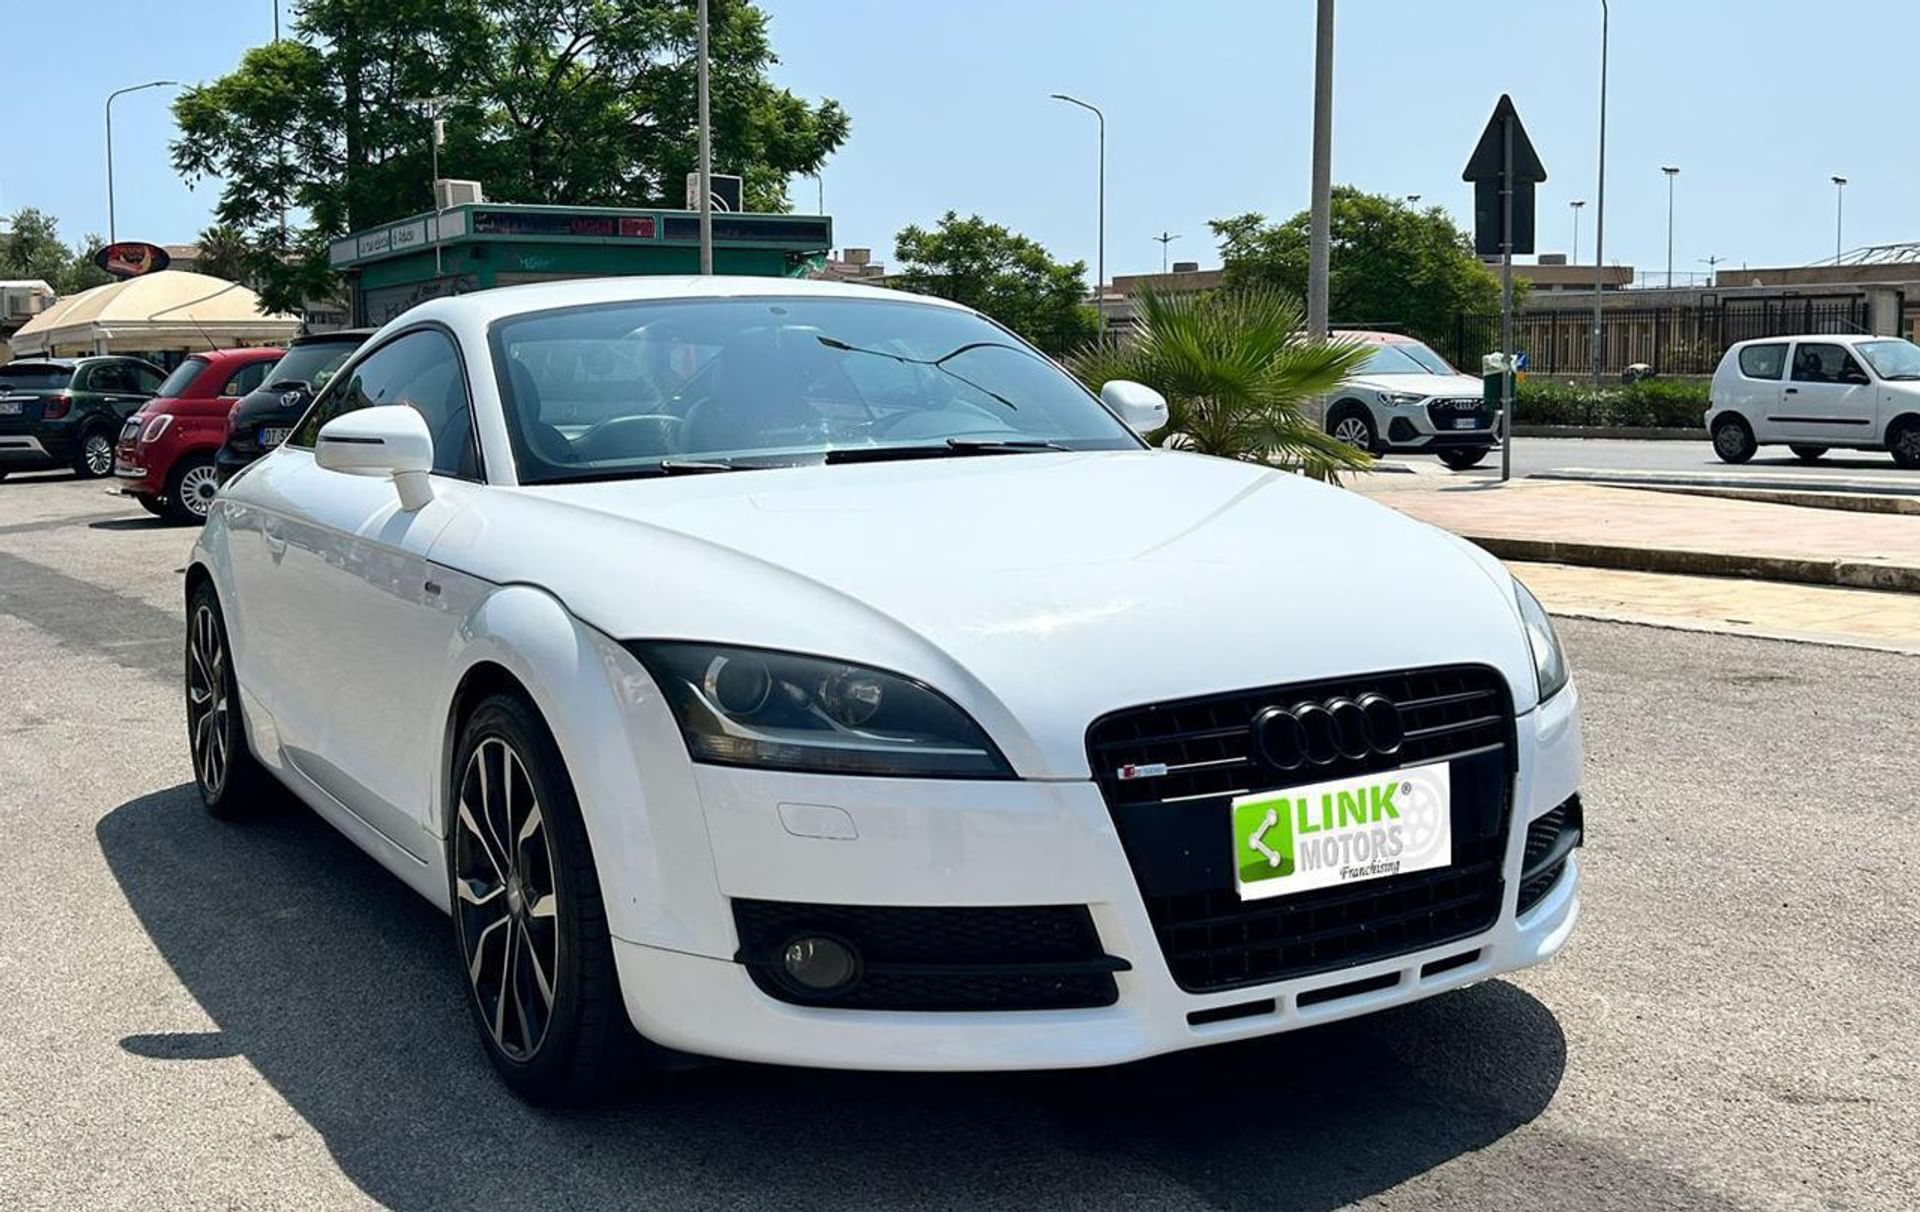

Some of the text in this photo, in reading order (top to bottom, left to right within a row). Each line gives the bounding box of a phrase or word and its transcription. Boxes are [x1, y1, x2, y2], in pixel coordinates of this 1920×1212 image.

[1297, 782, 1400, 834] LINK
[1301, 825, 1403, 871] MOTORS
[1340, 857, 1400, 880] Franchising
